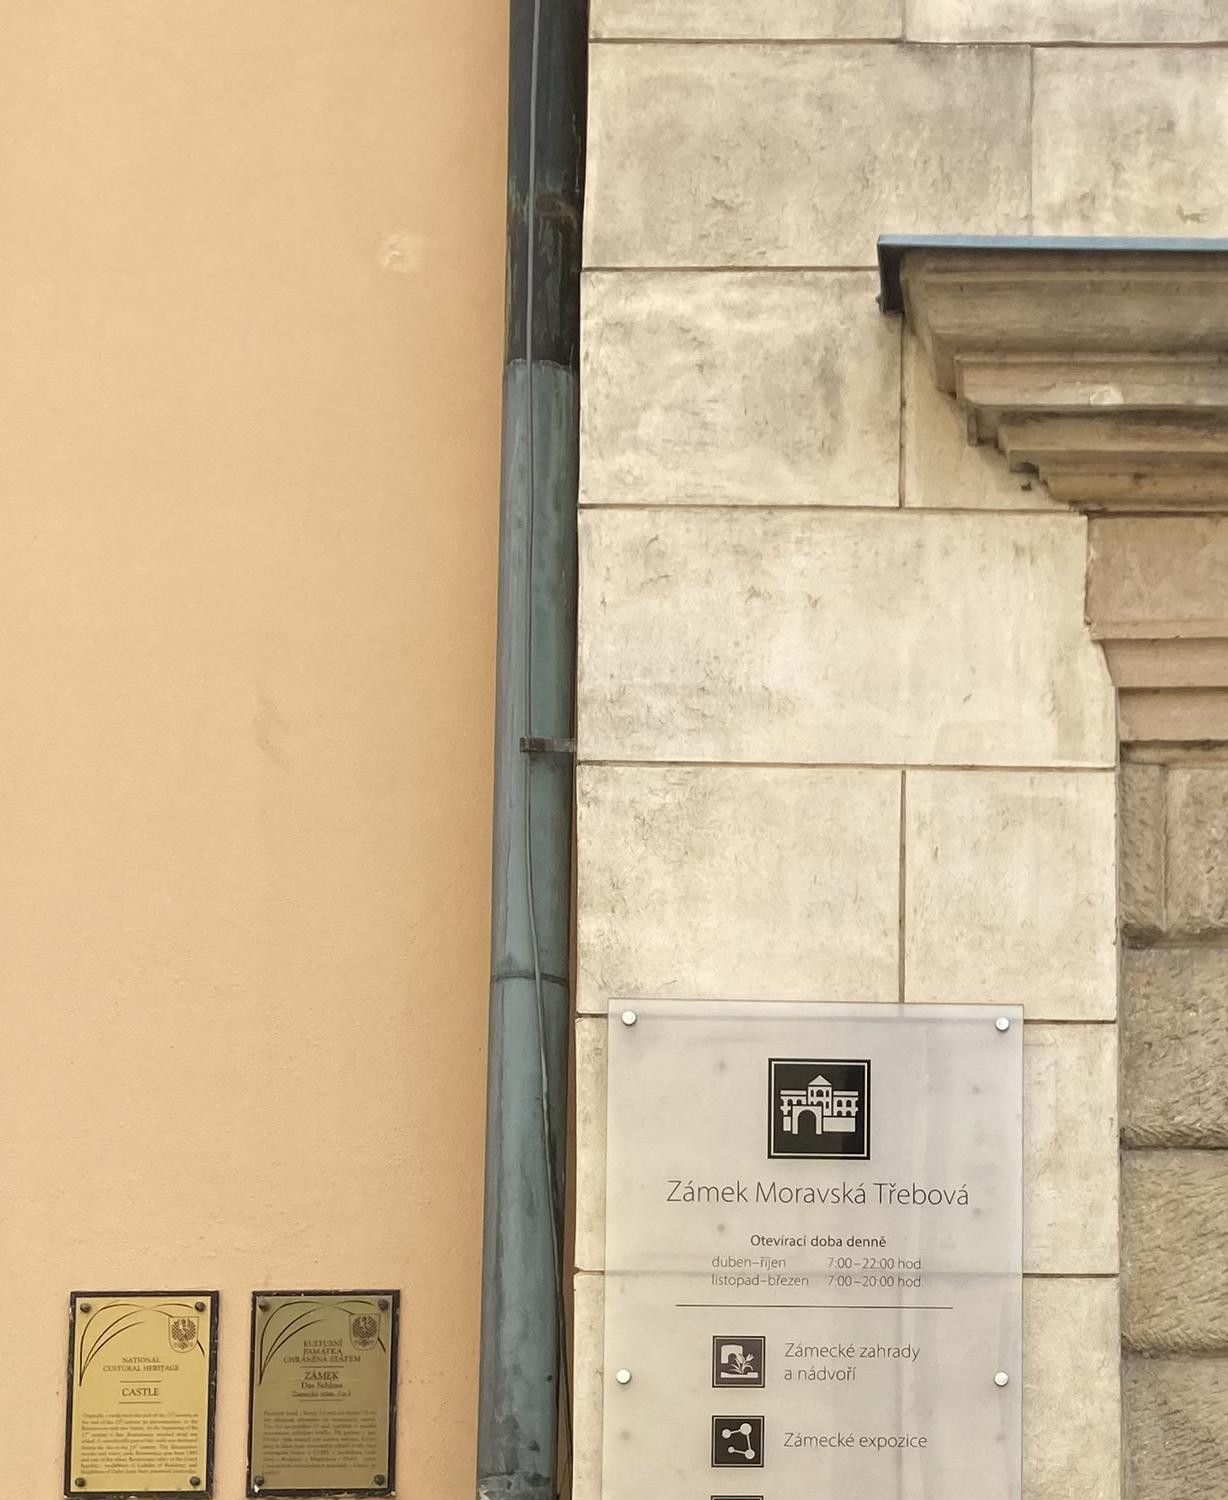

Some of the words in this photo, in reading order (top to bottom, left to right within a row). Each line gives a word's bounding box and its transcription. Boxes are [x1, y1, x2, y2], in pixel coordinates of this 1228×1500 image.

[667, 1180, 748, 1203] Zámek
[756, 1180, 866, 1205] Moravská
[873, 1182, 969, 1206] Třebová
[750, 1234, 806, 1247] Otevírací
[810, 1235, 842, 1248] doba
[846, 1235, 887, 1248] denně
[784, 1342, 855, 1358] Zámecké
[860, 1343, 920, 1362] zahrady
[784, 1369, 792, 1381] a
[798, 1365, 857, 1381] nádvoří
[121, 1387, 160, 1397] CASTLE
[783, 1432, 854, 1448] Zámecké
[859, 1435, 928, 1451] expozice
